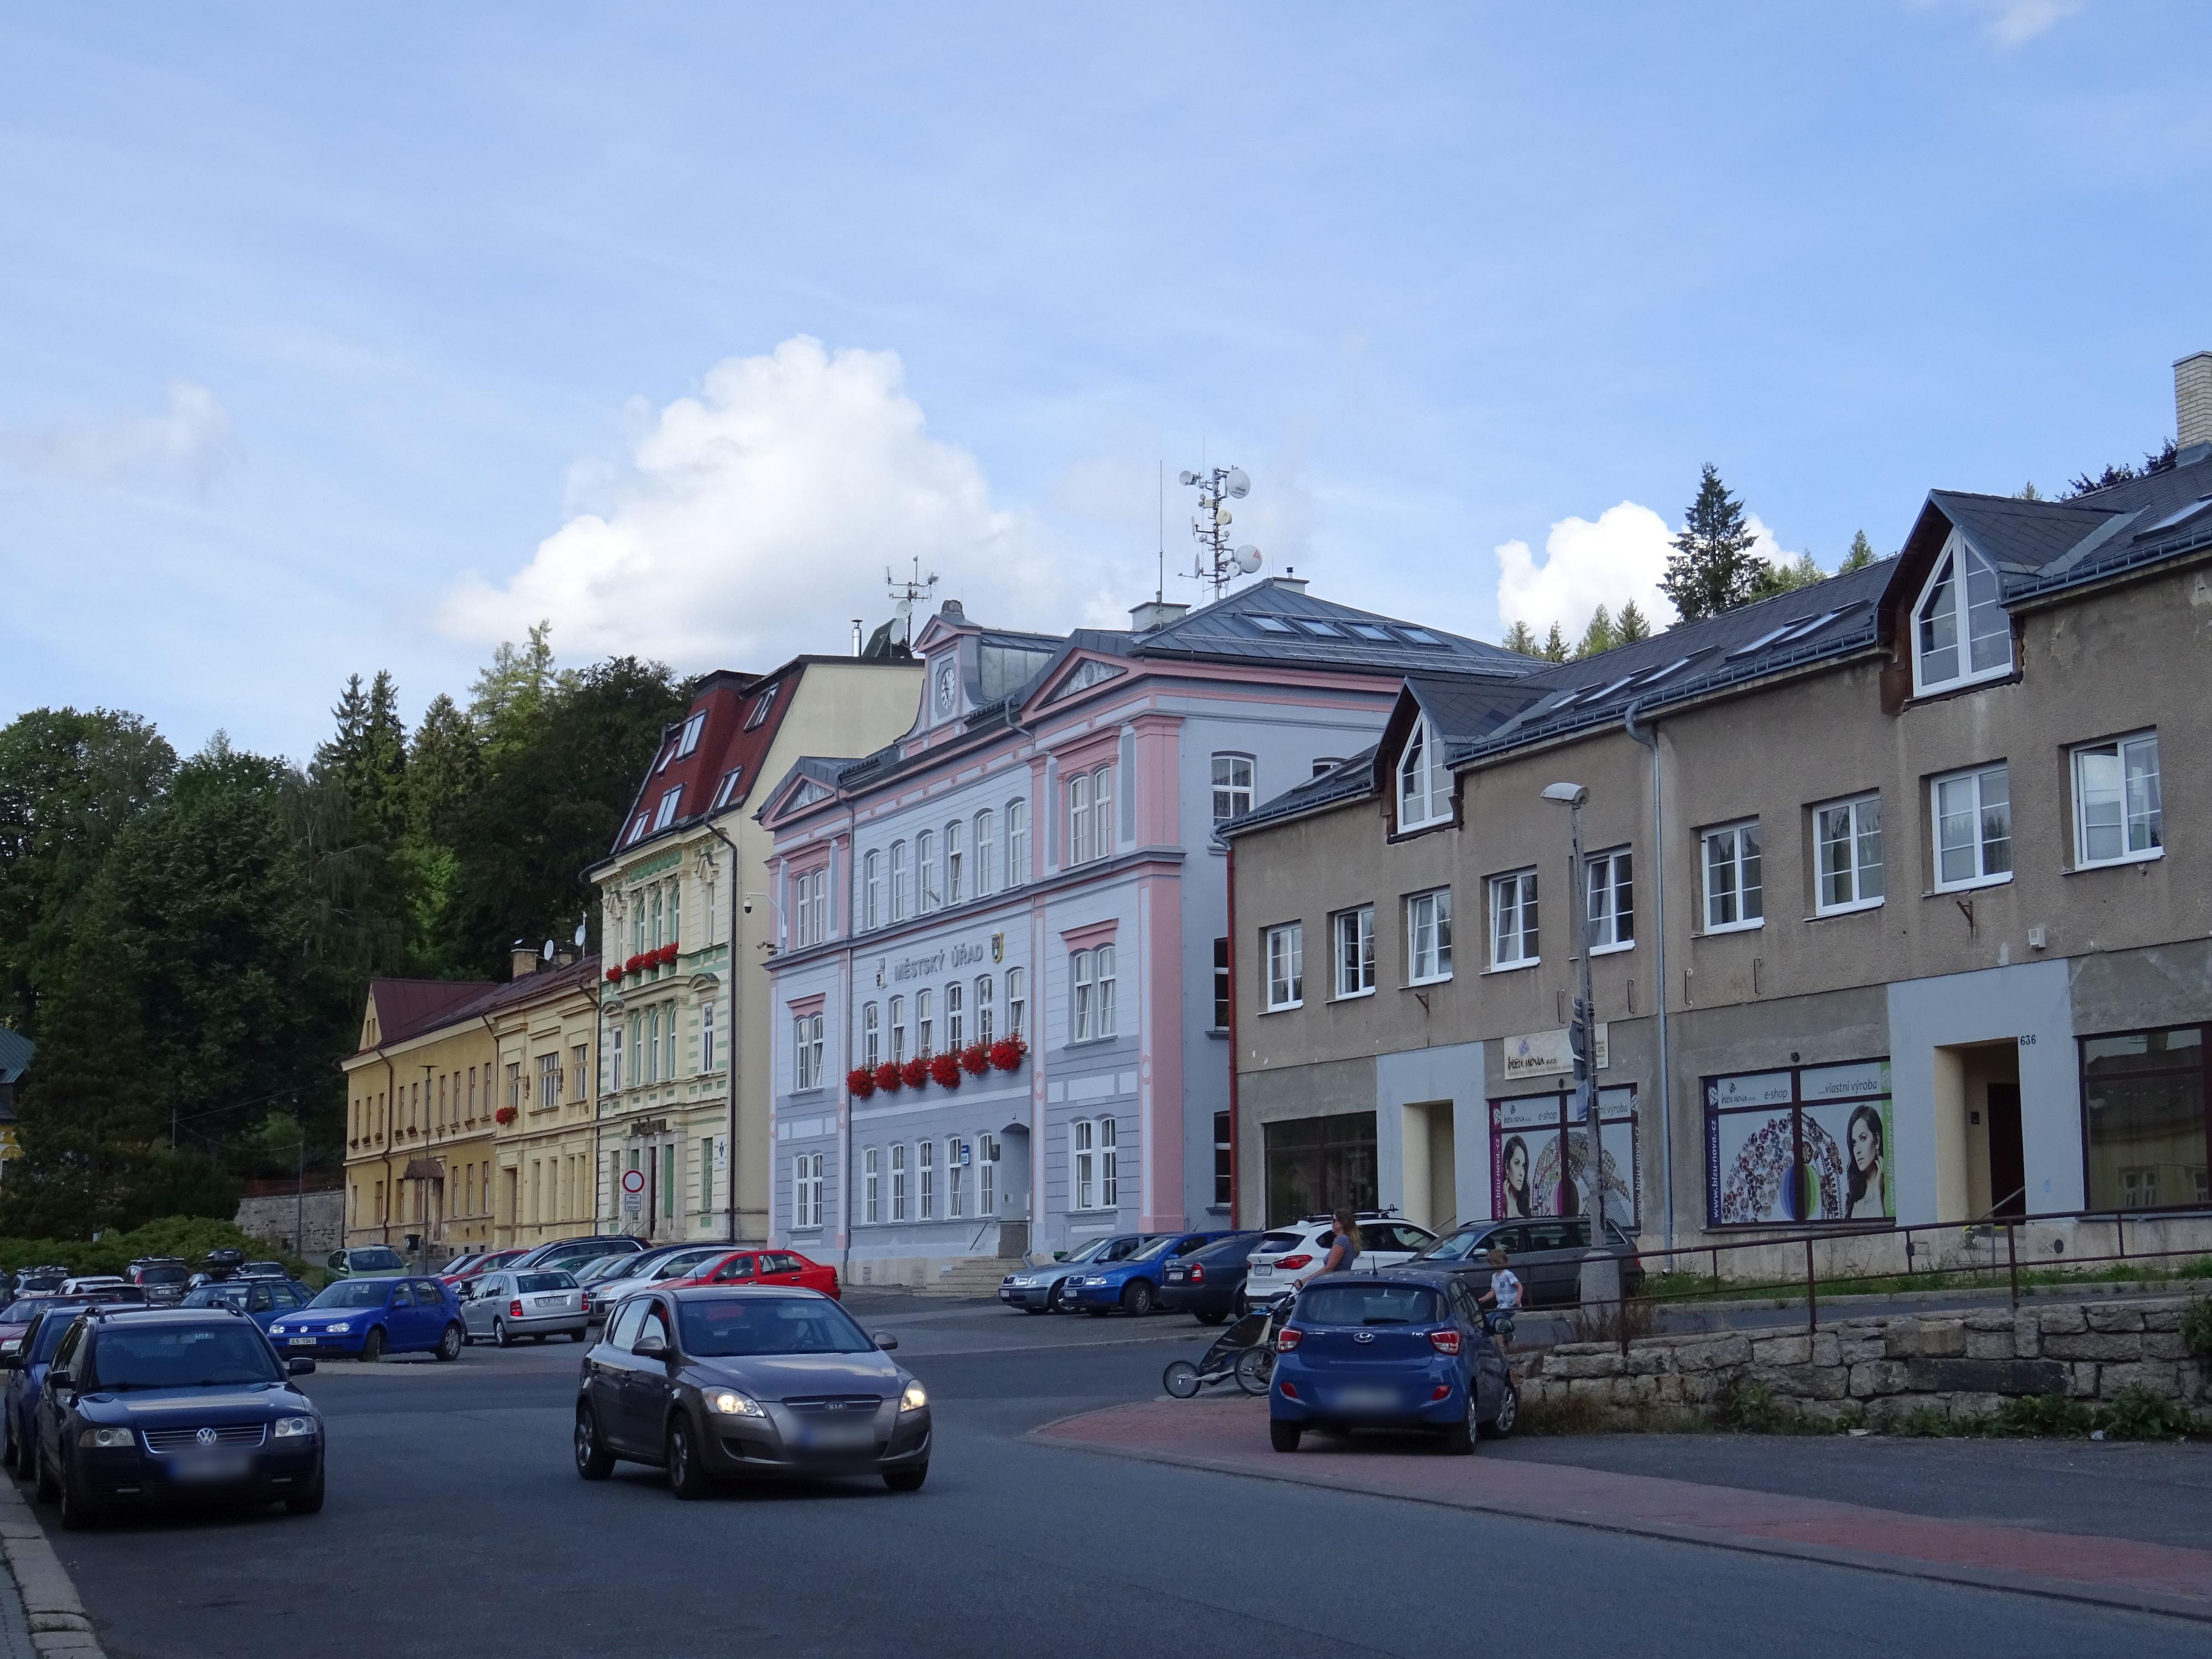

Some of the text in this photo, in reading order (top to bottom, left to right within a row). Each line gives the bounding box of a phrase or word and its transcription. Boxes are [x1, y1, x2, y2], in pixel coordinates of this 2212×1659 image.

[894, 943, 983, 982] MĚSTSKÝ ÚŘAD
[2020, 1035, 2036, 1045] 636
[1851, 1079, 1877, 1094] výroba
[1765, 1088, 1787, 1100] e-shop
[1608, 1103, 1627, 1116] výroba
[1538, 1111, 1557, 1121] e-shop
